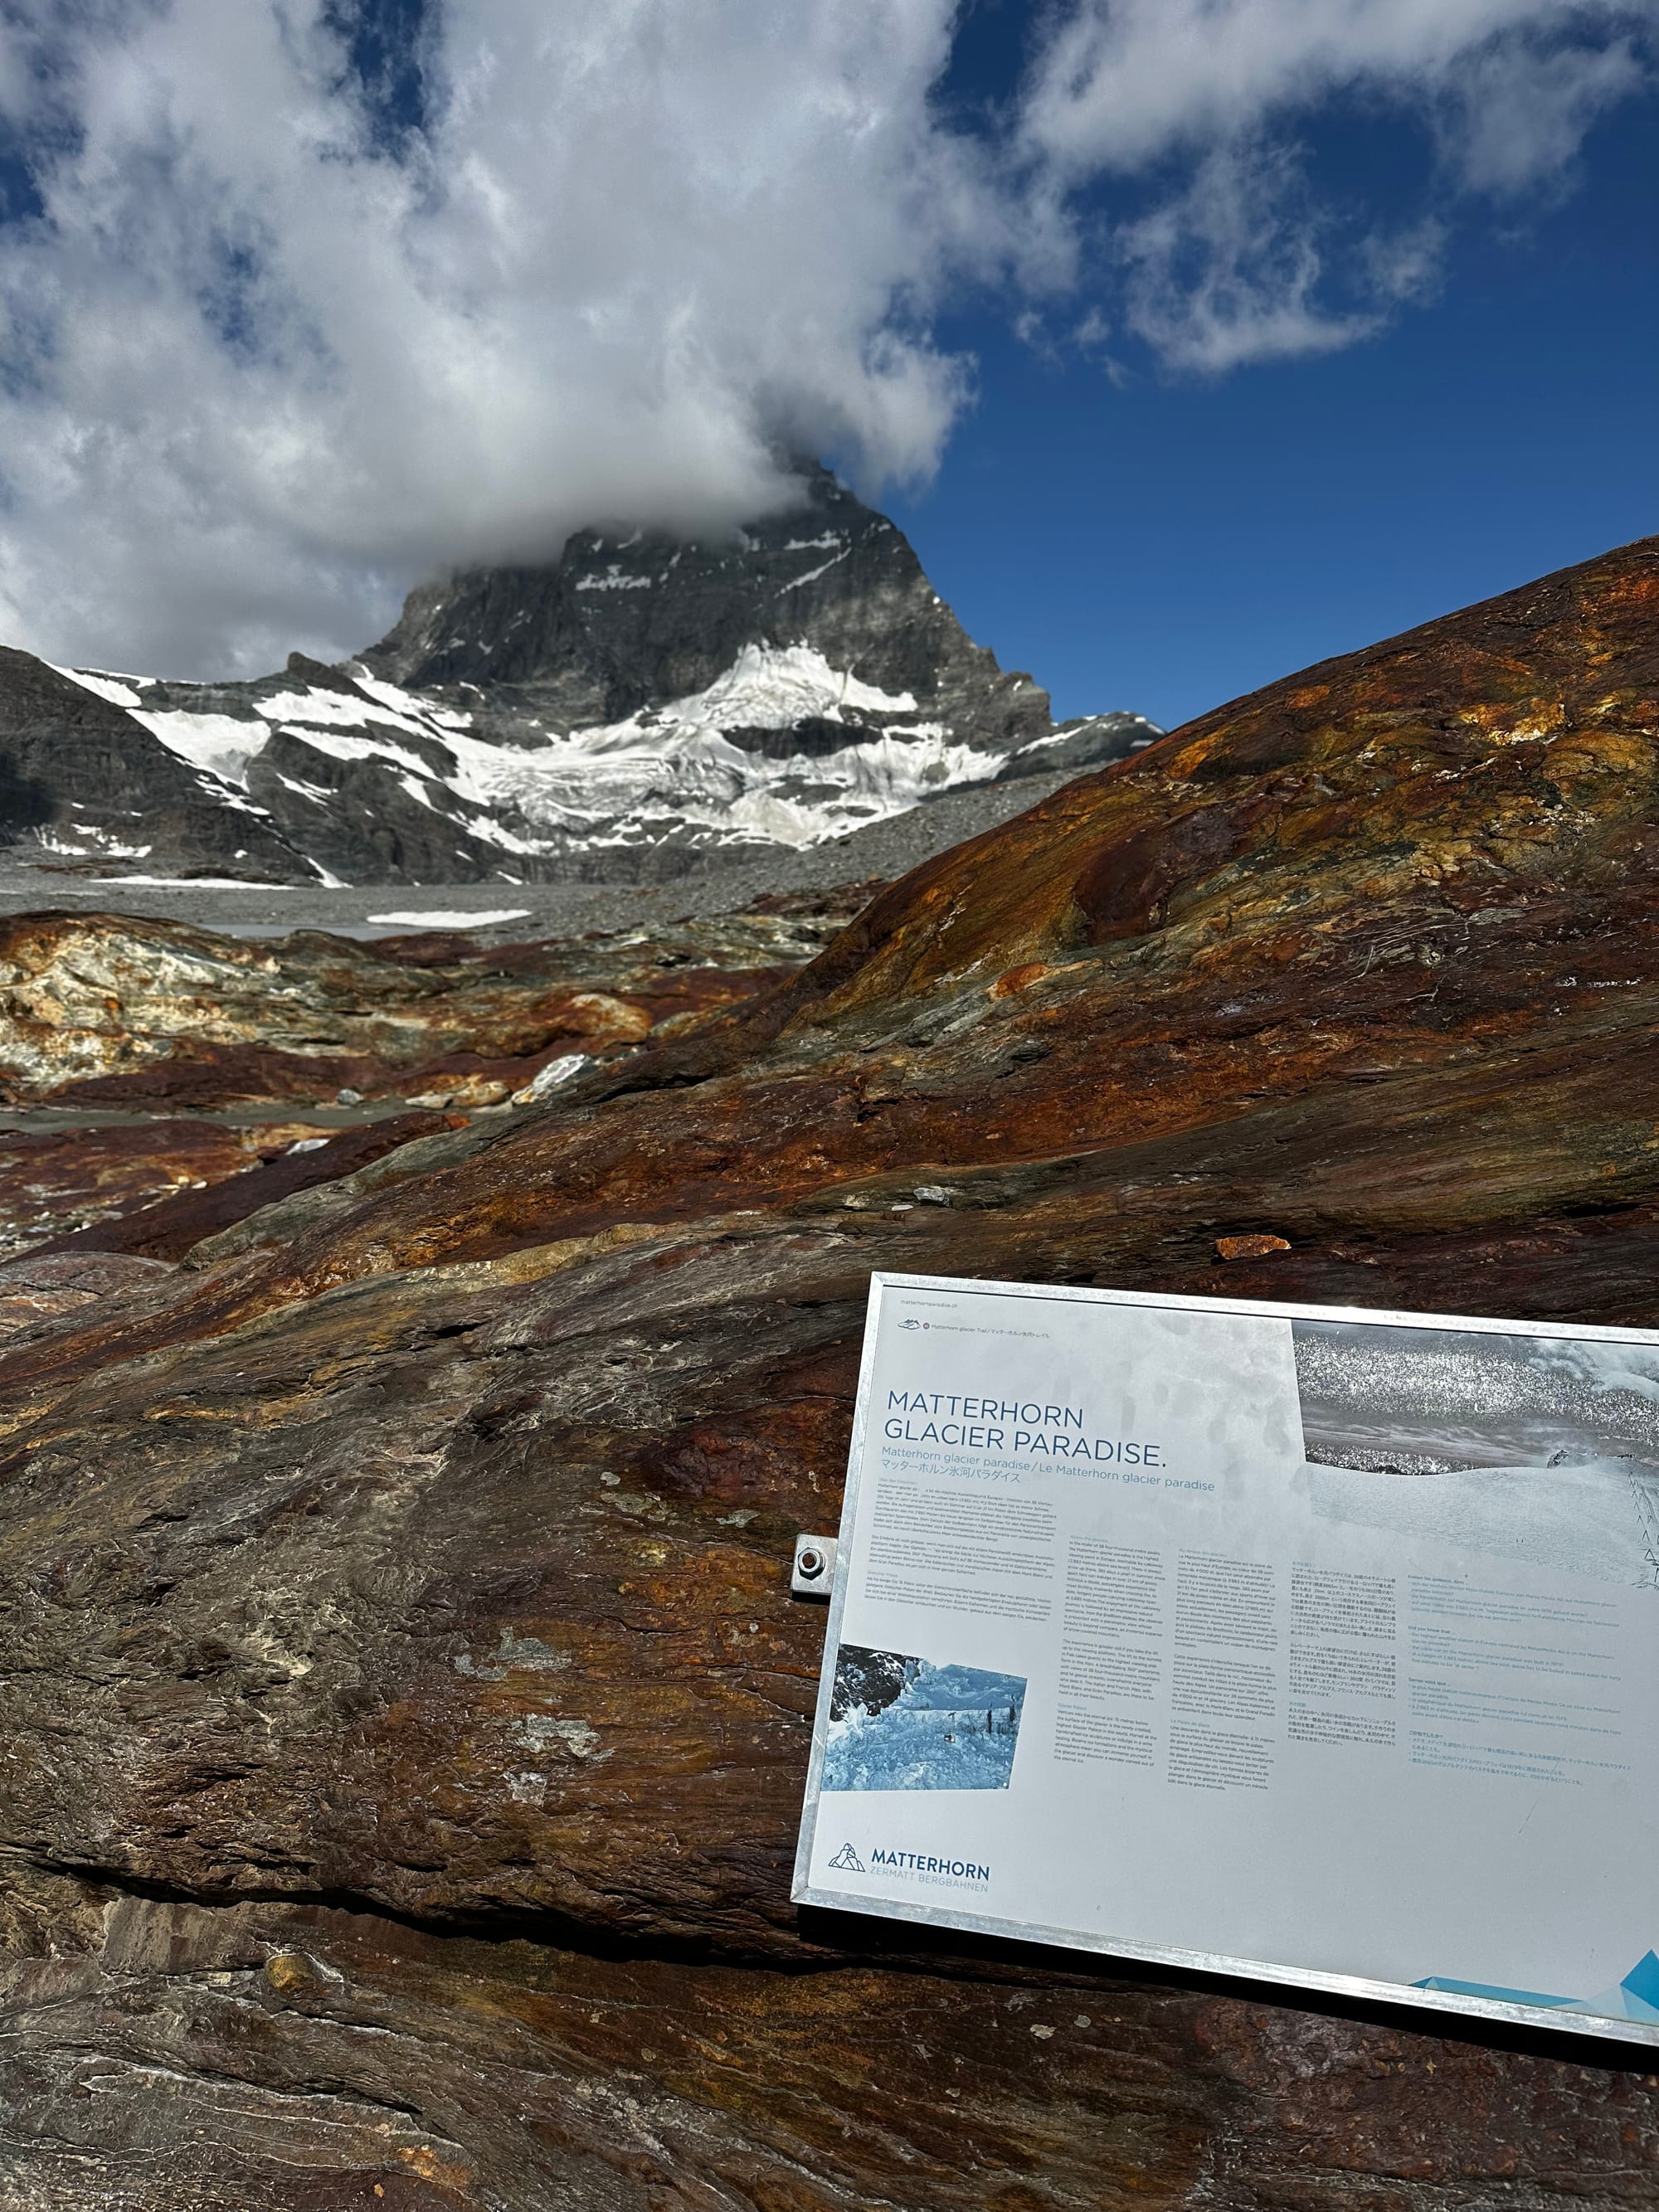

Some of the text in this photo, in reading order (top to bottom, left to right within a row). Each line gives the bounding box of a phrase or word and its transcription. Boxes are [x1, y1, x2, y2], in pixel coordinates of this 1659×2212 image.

[900, 1300, 958, 1308] matterhornparadise.ch
[888, 1390, 1084, 1429] MATTERHORN
[883, 1418, 1166, 1468] GLACIER PARADISE.
[882, 1446, 941, 1461] Matterhorn
[944, 1453, 980, 1466] glacier
[1056, 1465, 1119, 1480] Matterhorn
[1122, 1472, 1161, 1485] glacier
[1165, 1478, 1215, 1491] paradise
[882, 1459, 1020, 1483] マッターホルン氷河パラダイス
[869, 1865, 989, 1893] ZERMATT BERGBAHNEN
[871, 1848, 990, 1881] MATTERHORN
